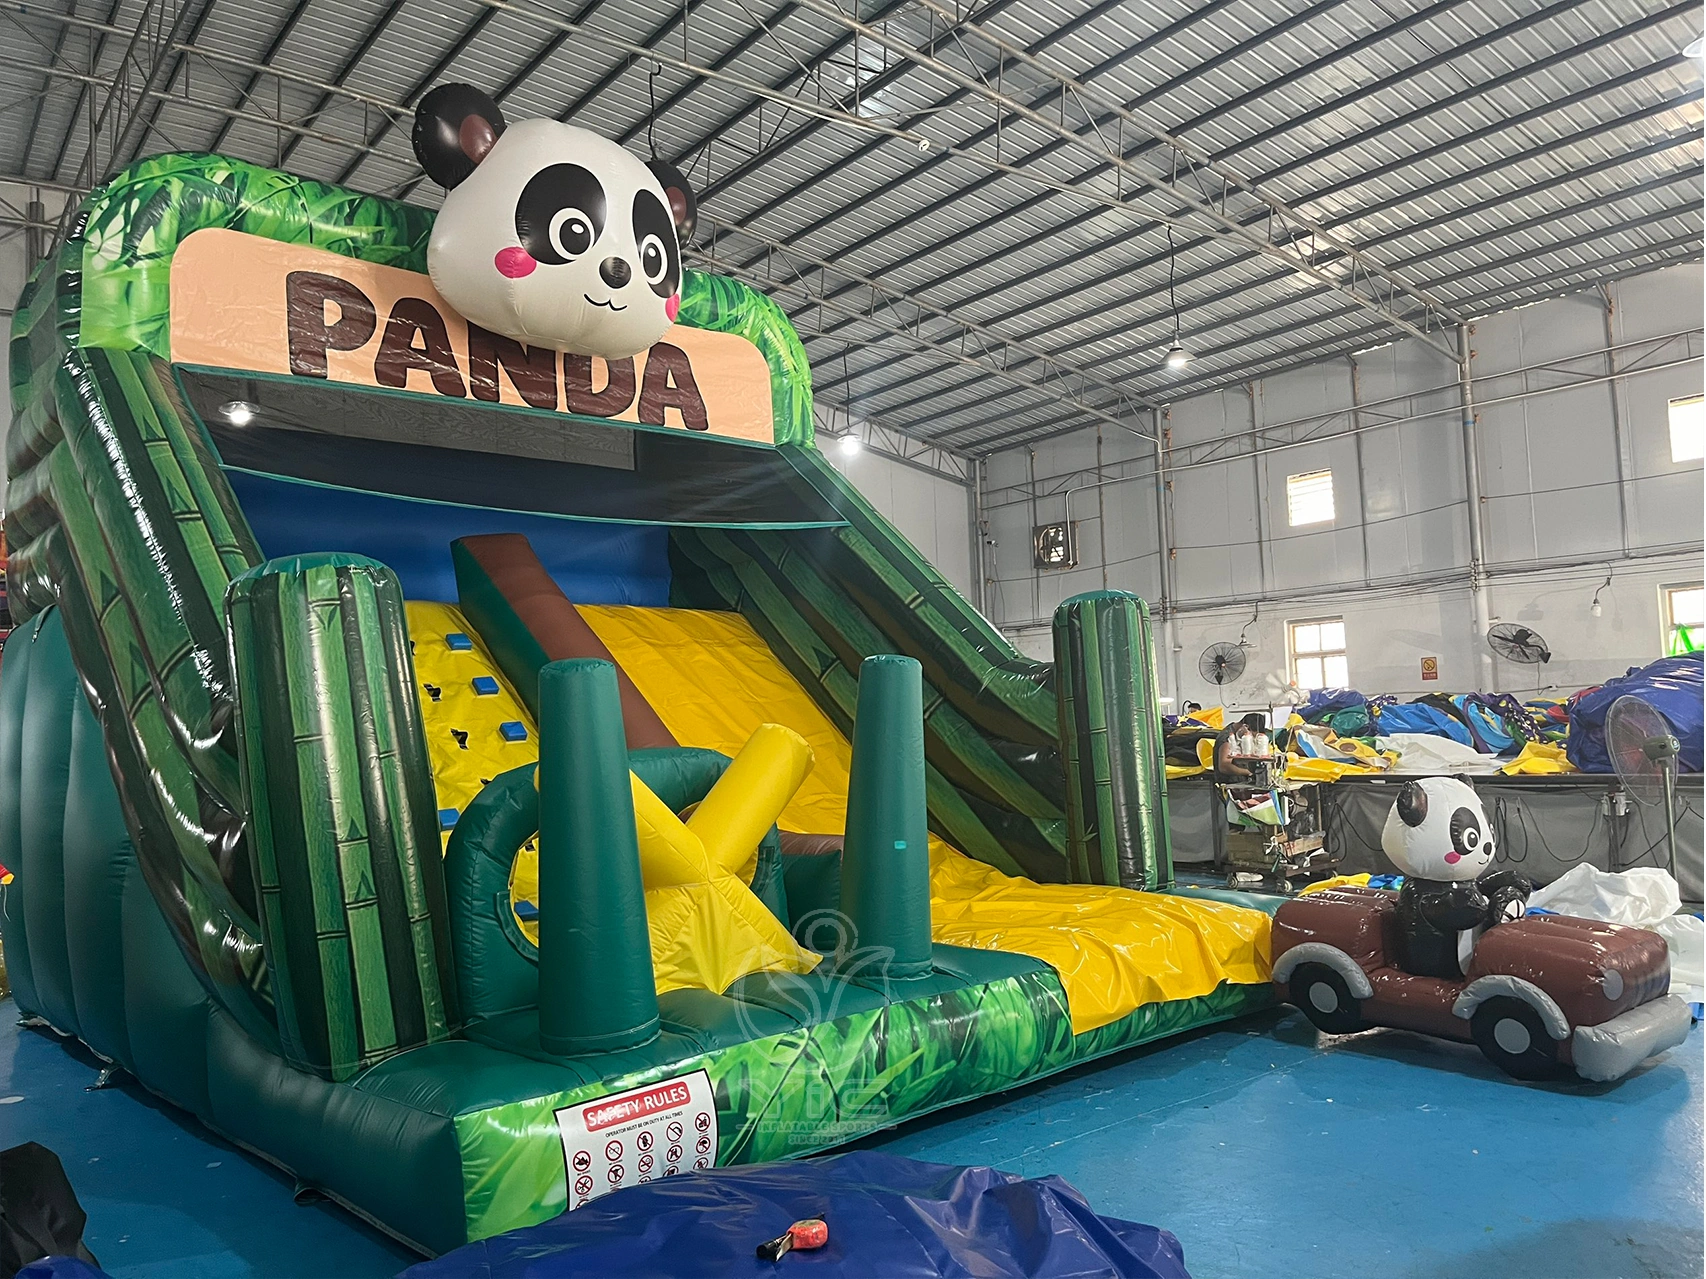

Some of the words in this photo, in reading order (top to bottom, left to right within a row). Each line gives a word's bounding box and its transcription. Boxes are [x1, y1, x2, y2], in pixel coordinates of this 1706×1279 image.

[286, 270, 709, 430] PANDA
[586, 1098, 640, 1127] SAFETY
[643, 1086, 687, 1110] RULES
[605, 1127, 627, 1138] OPERATOR
